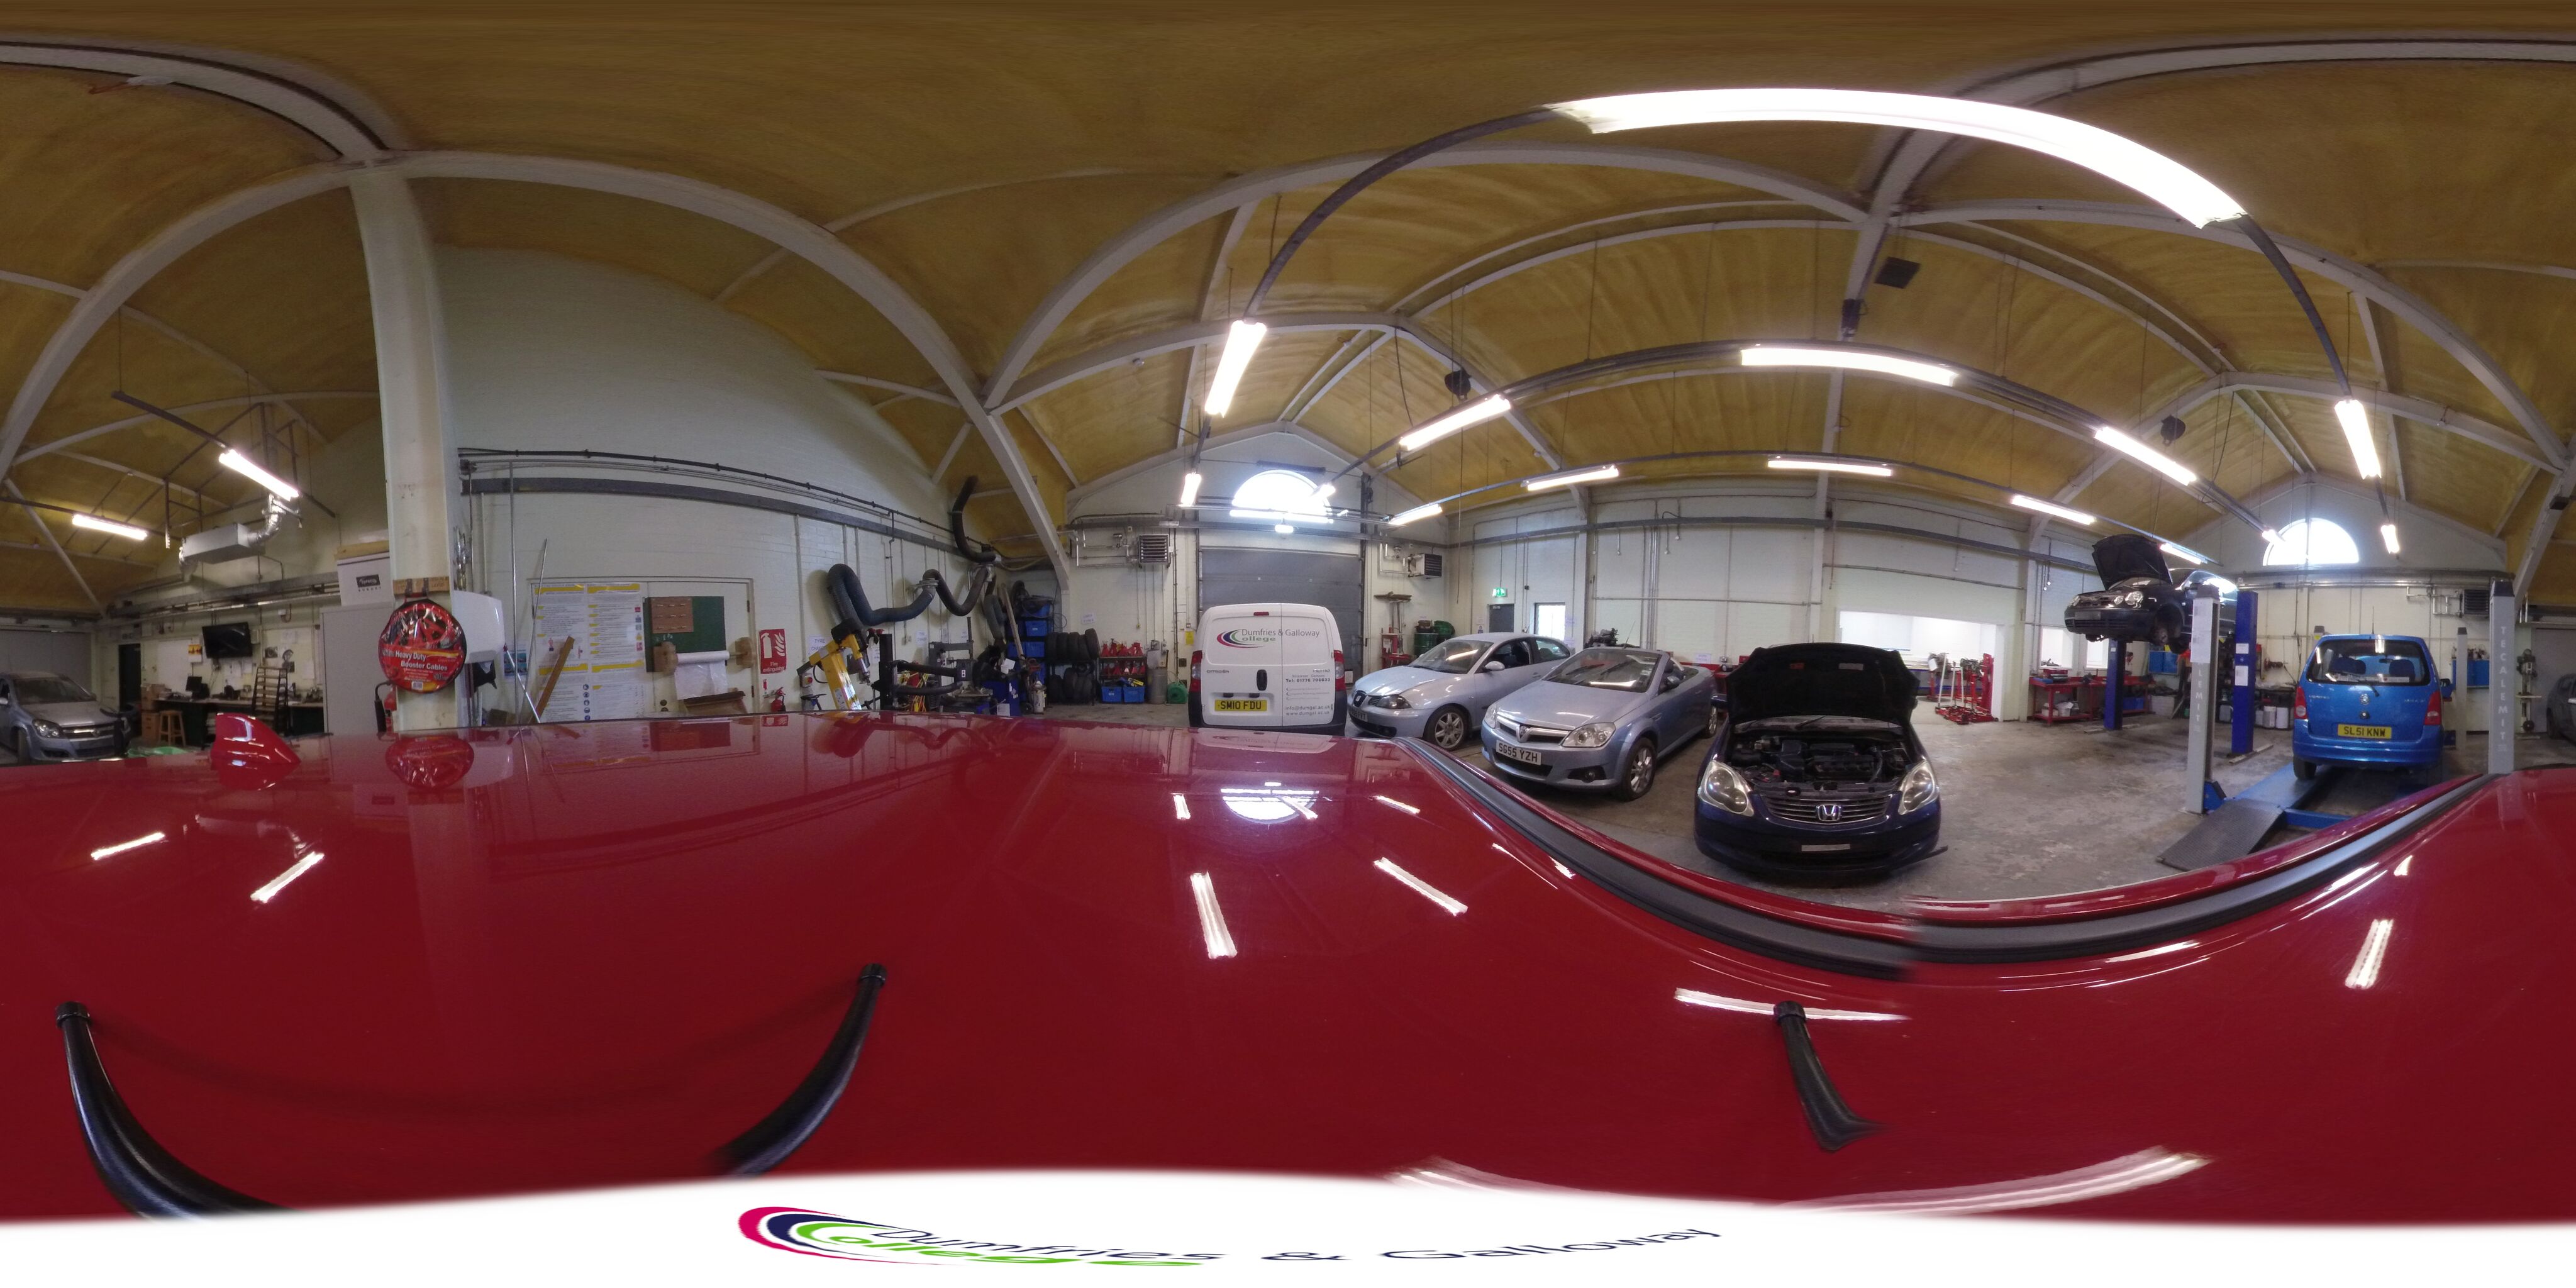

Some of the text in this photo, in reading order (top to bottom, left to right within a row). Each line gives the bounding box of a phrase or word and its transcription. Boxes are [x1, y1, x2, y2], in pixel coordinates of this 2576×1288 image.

[1285, 629, 1319, 638] Galloway
[395, 650, 412, 660] Heavy
[413, 652, 426, 662] Duty
[401, 660, 448, 671] Booster Cables
[2498, 626, 2508, 740] TECALEMIT
[1220, 701, 1262, 709] SM10 FDU
[2367, 728, 2385, 736] KNW
[1499, 743, 1538, 762] SG55 YZH
